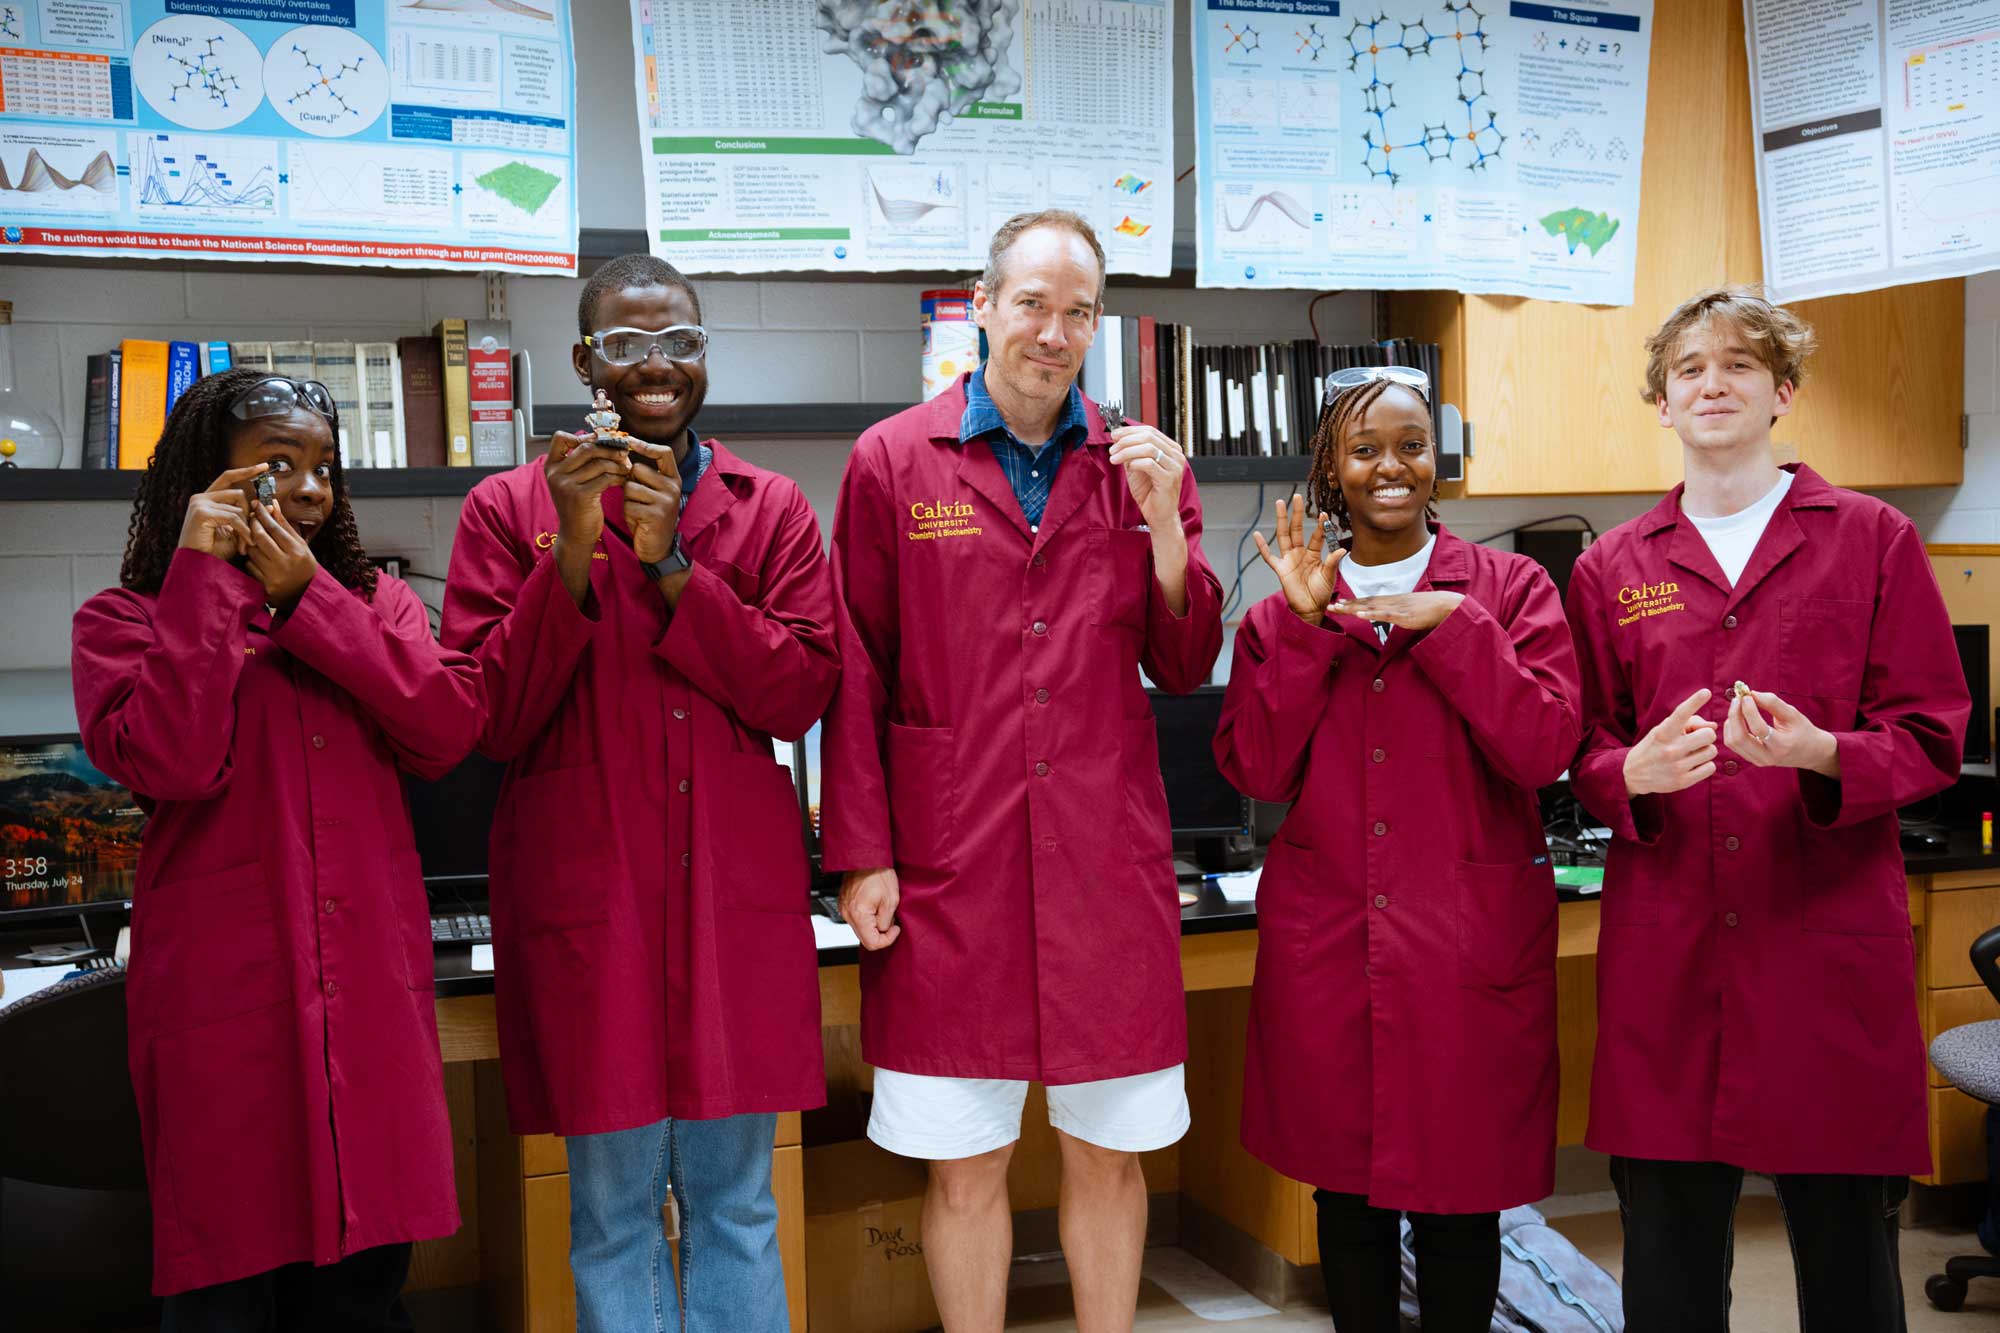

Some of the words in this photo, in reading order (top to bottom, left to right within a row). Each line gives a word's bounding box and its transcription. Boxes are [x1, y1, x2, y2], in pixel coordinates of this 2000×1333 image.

[288, 0, 331, 10] overtakes
[1236, 0, 1294, 12] Non-Bridging
[1296, 2, 1330, 13] Species
[170, 2, 220, 15] bidenticity,
[223, 7, 268, 18] seemingly
[270, 10, 297, 19] driven
[299, 13, 310, 22] by
[311, 15, 351, 25] enthalpy.
[1552, 10, 1568, 20] The
[1569, 11, 1598, 24] Square
[978, 106, 1014, 116] Formulae
[1801, 123, 1838, 137] Objectives
[715, 140, 767, 150] Conclusions
[708, 230, 780, 240] Acknowledgements
[41, 232, 61, 243] The
[63, 233, 103, 244] authors
[105, 234, 136, 244] would
[138, 236, 157, 245] like
[160, 238, 169, 246] to
[172, 237, 200, 248] thank
[202, 238, 219, 248] the
[221, 239, 263, 250] National
[265, 241, 304, 252] Science
[306, 242, 360, 254] Foundation
[361, 244, 375, 254] for
[377, 246, 413, 257] support
[414, 247, 449, 258] through
[463, 250, 480, 259] RUI
[481, 250, 504, 261] grant
[911, 500, 976, 520] Calvin
[918, 518, 969, 530] UNIVERSITY
[908, 531, 936, 540] Chemistry
[937, 529, 943, 537] &
[943, 526, 982, 537] Biochemistry
[1618, 581, 1680, 604] Calvin
[1626, 596, 1672, 613] UNIVERSITY
[1641, 609, 1647, 617] &
[1647, 602, 1685, 616] Biochemistry
[5, 856, 48, 878] 3:58
[6, 879, 50, 891] Thursday,
[51, 876, 69, 889] July
[71, 875, 83, 886] 24
[865, 1227, 905, 1248] Dave
